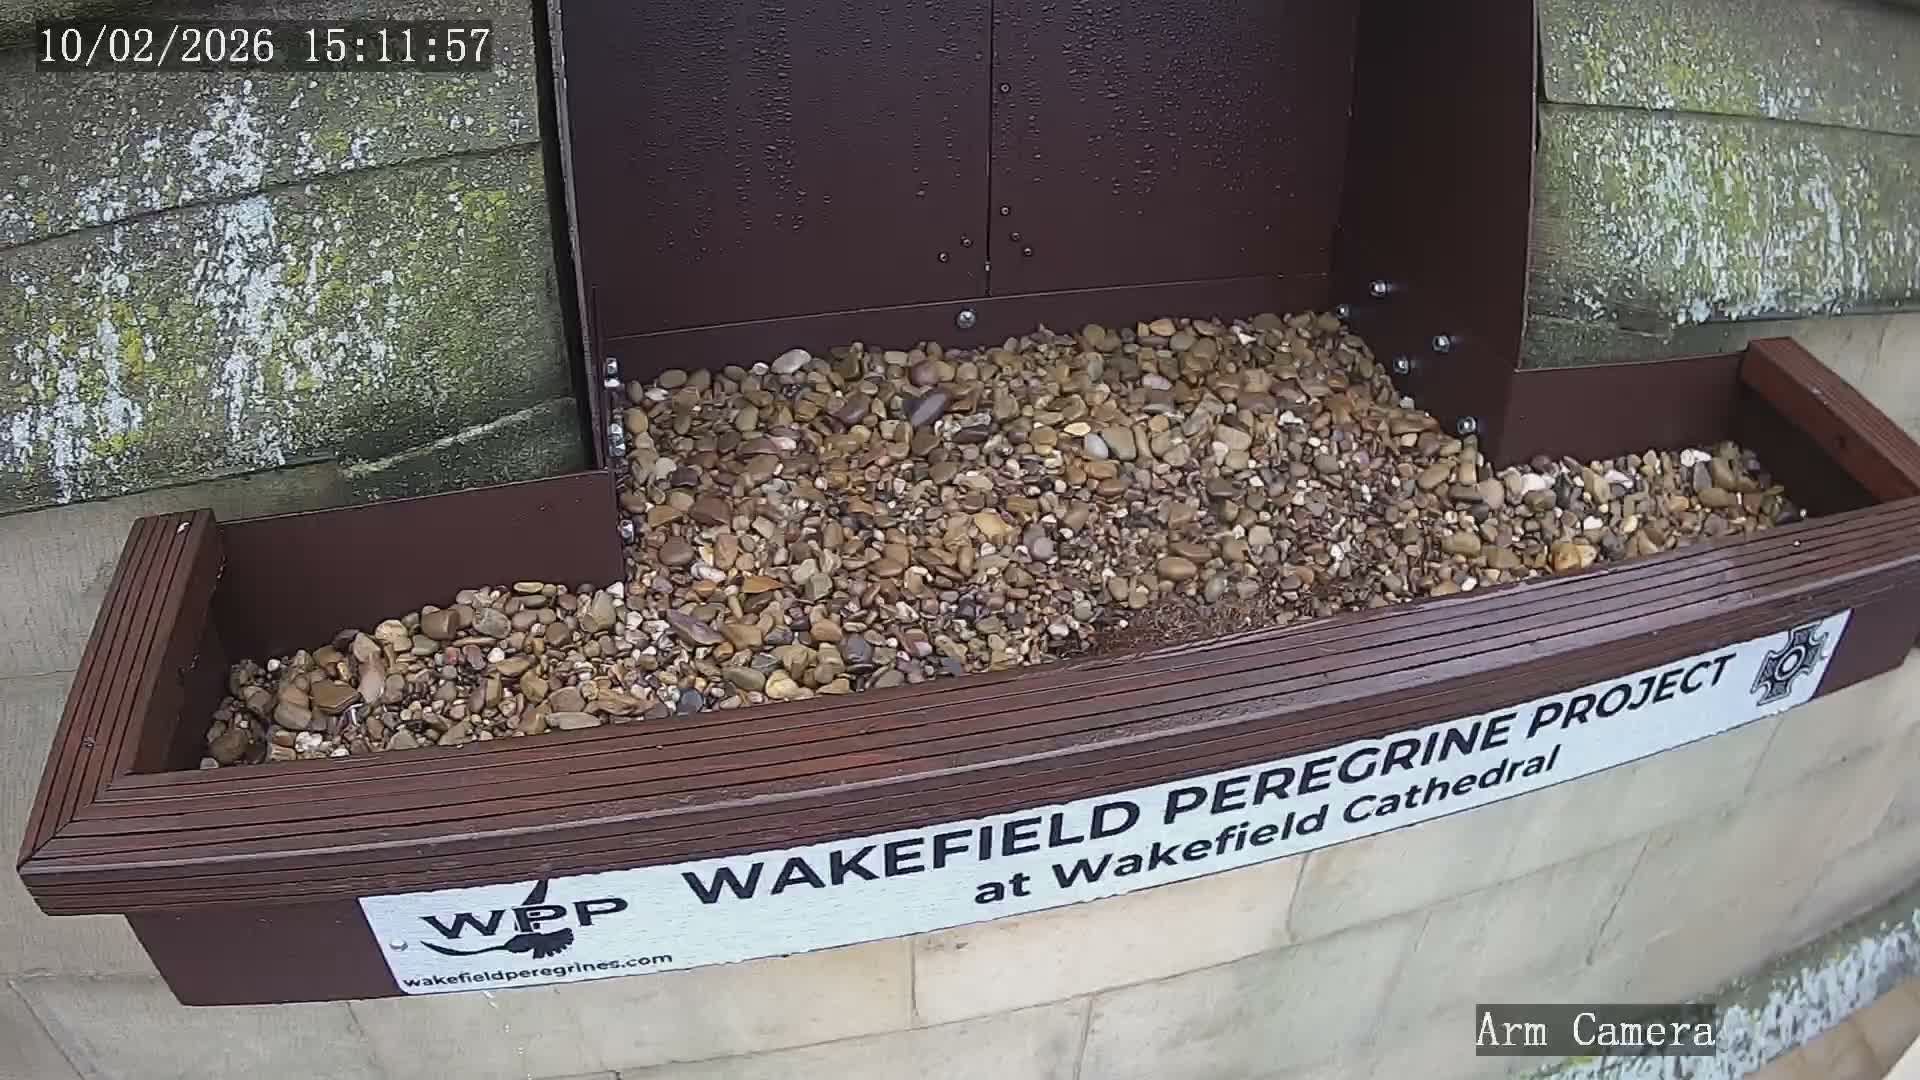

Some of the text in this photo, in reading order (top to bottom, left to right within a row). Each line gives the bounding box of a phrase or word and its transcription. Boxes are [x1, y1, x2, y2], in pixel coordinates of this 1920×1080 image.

[682, 653, 1736, 905] WAKEFIELD PEREGRINE PROJECT
[974, 744, 1562, 905] at Wakefield Cathedral
[418, 897, 629, 939] WPP
[403, 953, 673, 988] wakefieldperegrines.com
